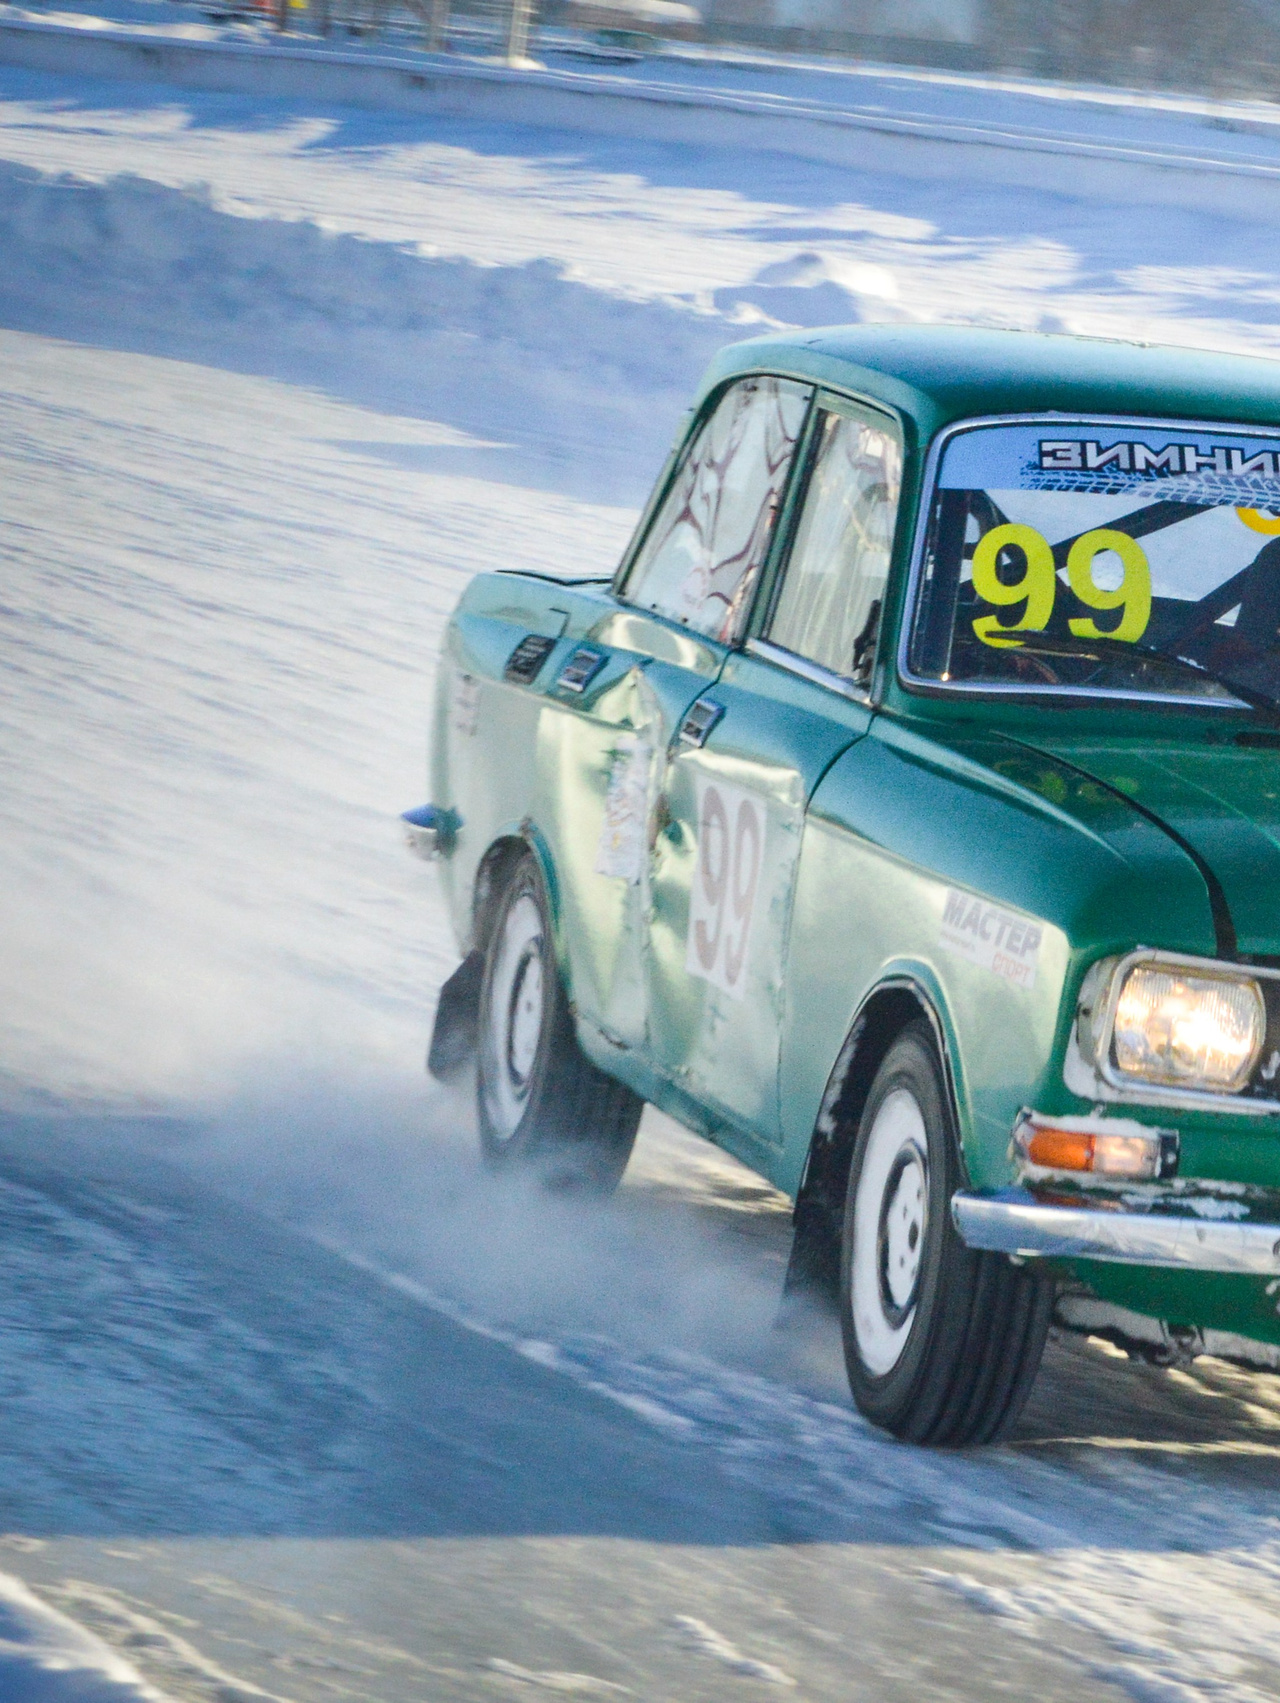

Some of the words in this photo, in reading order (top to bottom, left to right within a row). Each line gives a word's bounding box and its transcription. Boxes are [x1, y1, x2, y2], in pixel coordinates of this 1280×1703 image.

[971, 523, 1152, 648] 99
[696, 786, 761, 987] 99
[943, 889, 1043, 957] МАСТЕР
